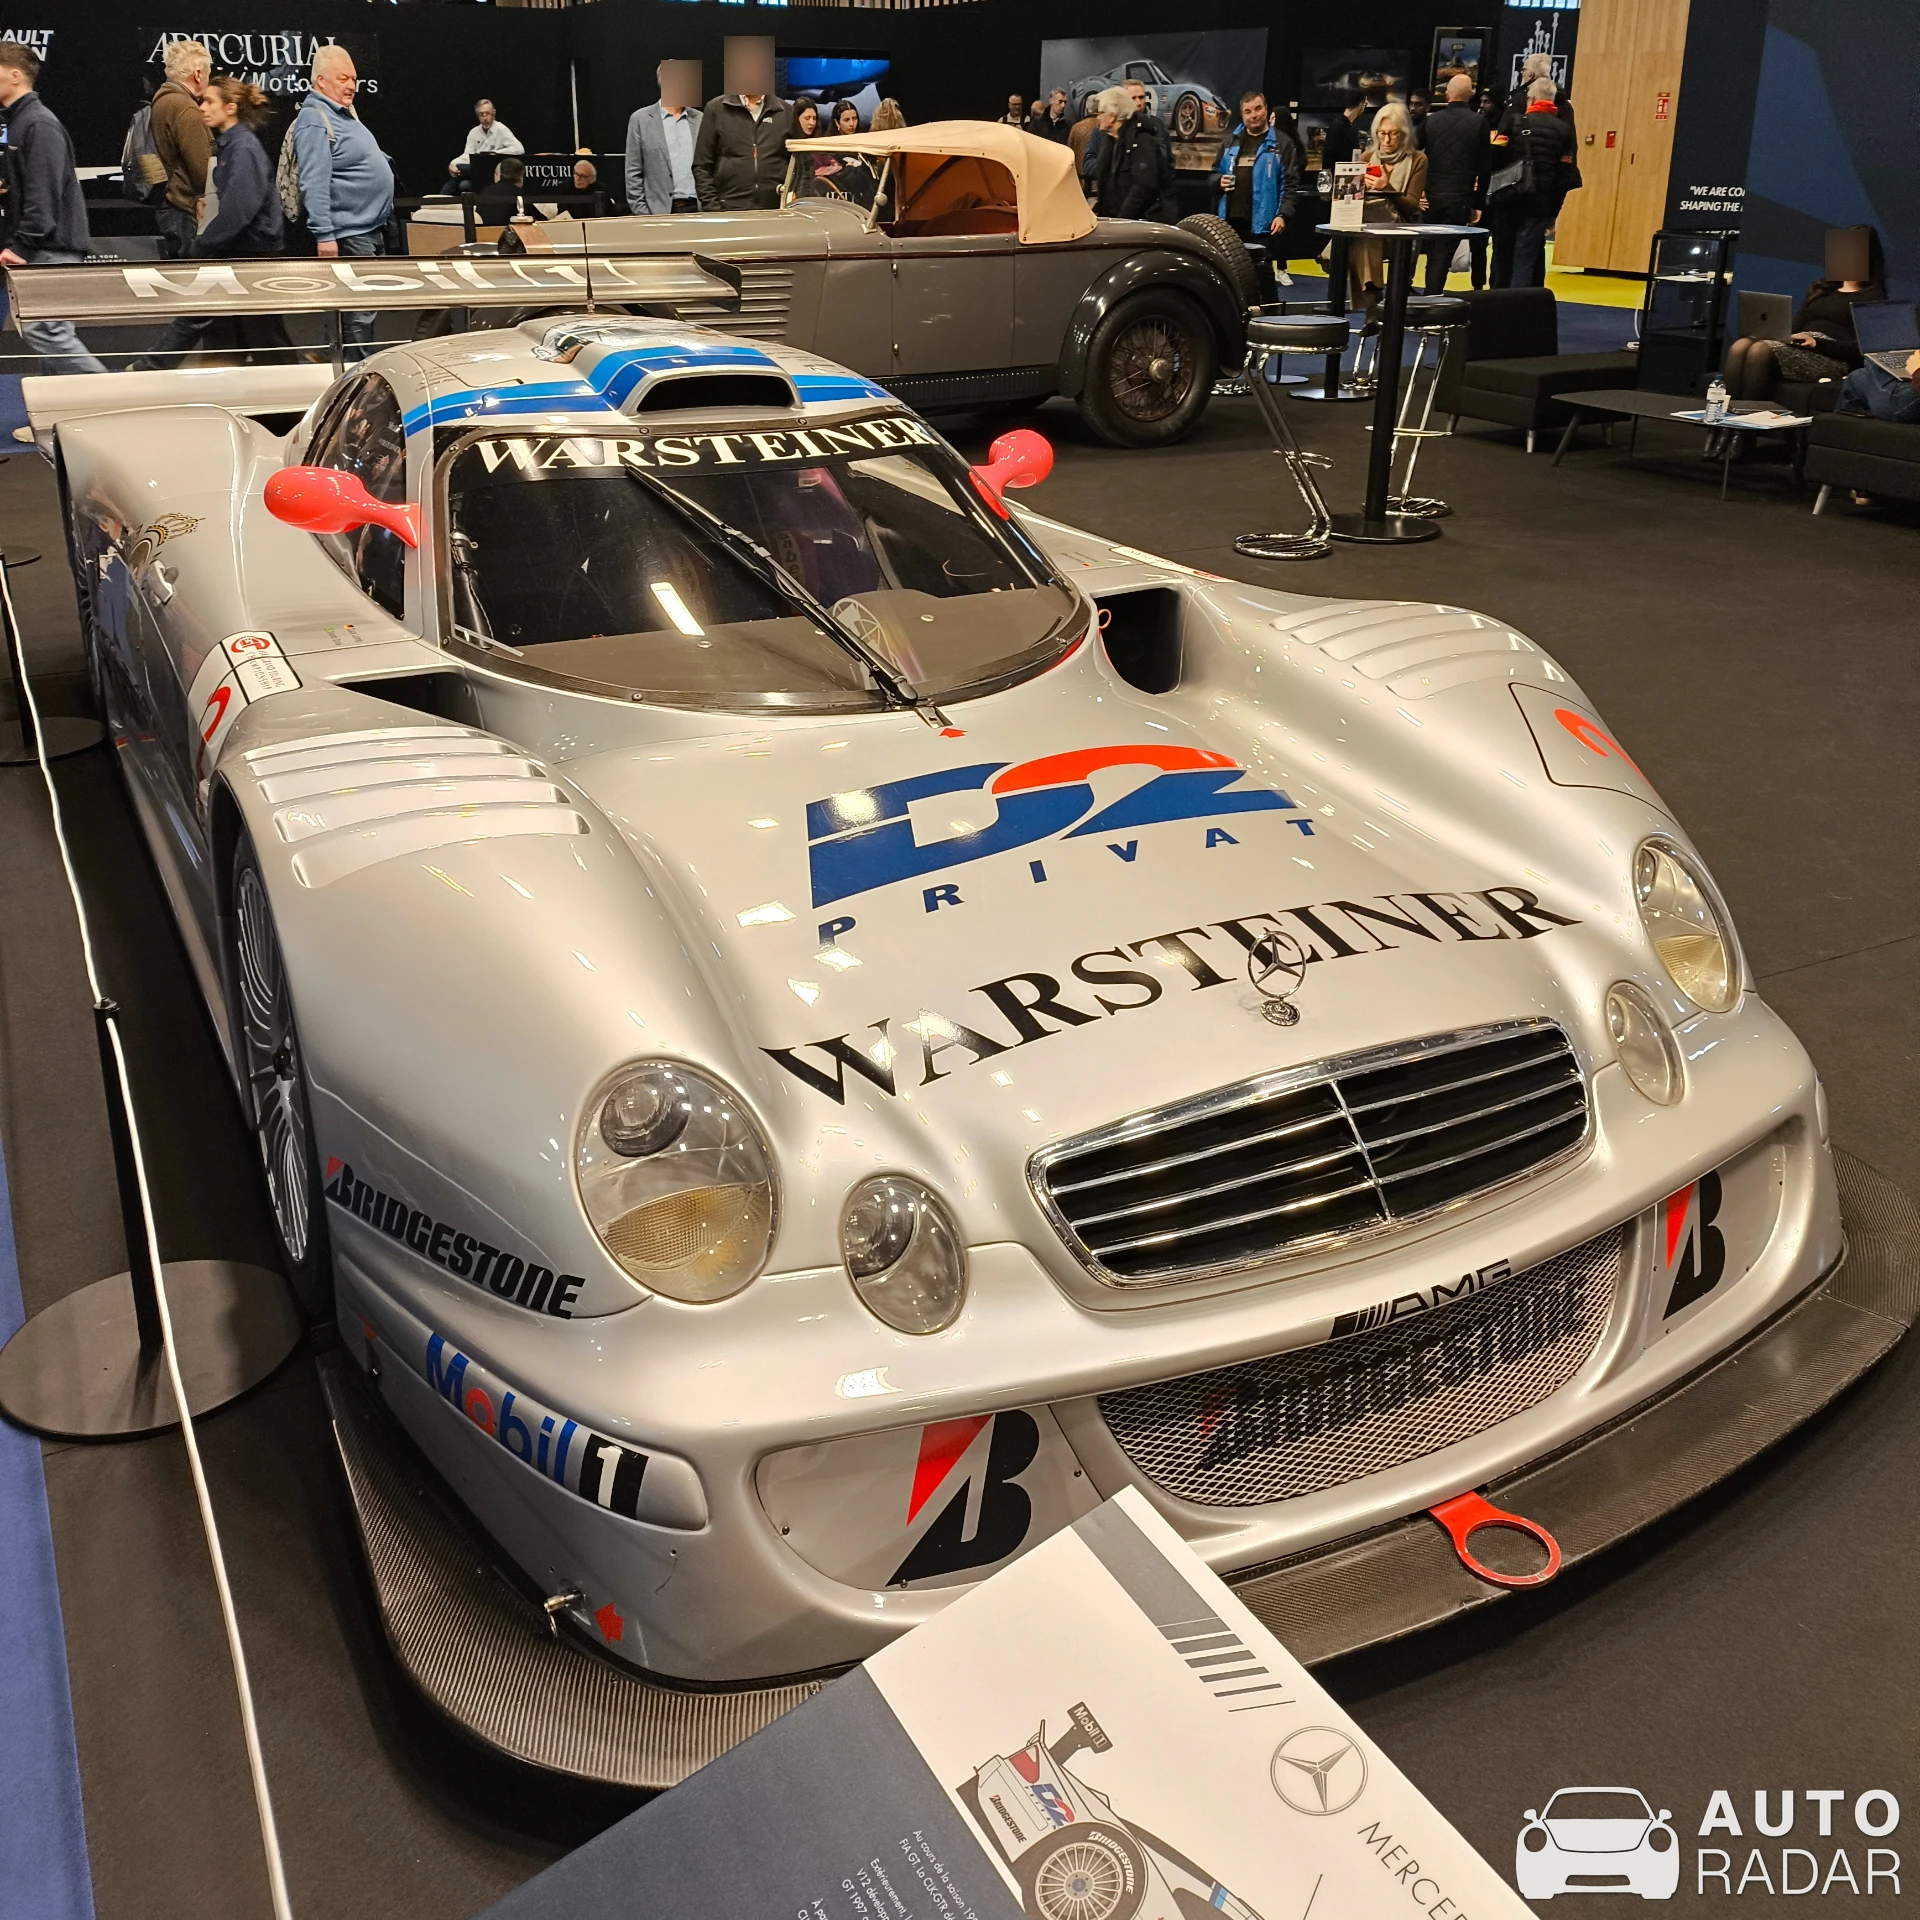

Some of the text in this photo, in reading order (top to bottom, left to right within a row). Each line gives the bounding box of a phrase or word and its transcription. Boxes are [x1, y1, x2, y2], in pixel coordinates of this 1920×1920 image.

[0, 29, 54, 45] AULT
[146, 32, 338, 65] ATCURIA
[525, 165, 571, 178] RTCURI
[1708, 187, 1726, 197] ARE
[1680, 200, 1740, 212] SHAPING THE
[122, 262, 498, 297] Mobil
[475, 417, 940, 474] WARSTEINER
[805, 745, 1298, 909] D2
[817, 818, 1315, 950] PRIVAT
[758, 884, 1583, 1106] WARSTEINER
[324, 1156, 586, 1320] BRIDGESTONE
[1386, 1258, 1511, 1321] AMG
[425, 1332, 578, 1487] Mobil
[1073, 1705, 1100, 1738] Mobil
[989, 1794, 1027, 1844] BRIDGESTONE
[1030, 1783, 1075, 1826] D2
[857, 1868, 872, 1887] V12
[870, 1858, 908, 1918] Extérieurement,
[898, 1838, 910, 1855] FIA
[916, 1866, 926, 1879] La
[923, 1877, 948, 1916] CLK-GTR
[913, 1830, 924, 1842] Au
[920, 1842, 937, 1863] cours
[933, 1862, 944, 1874] de
[941, 1871, 950, 1884] la
[946, 1882, 965, 1909] saison
[1087, 1831, 1135, 1895] BRIDGESTONE
[842, 1879, 855, 1893] GT
[849, 1891, 868, 1914] 1997
